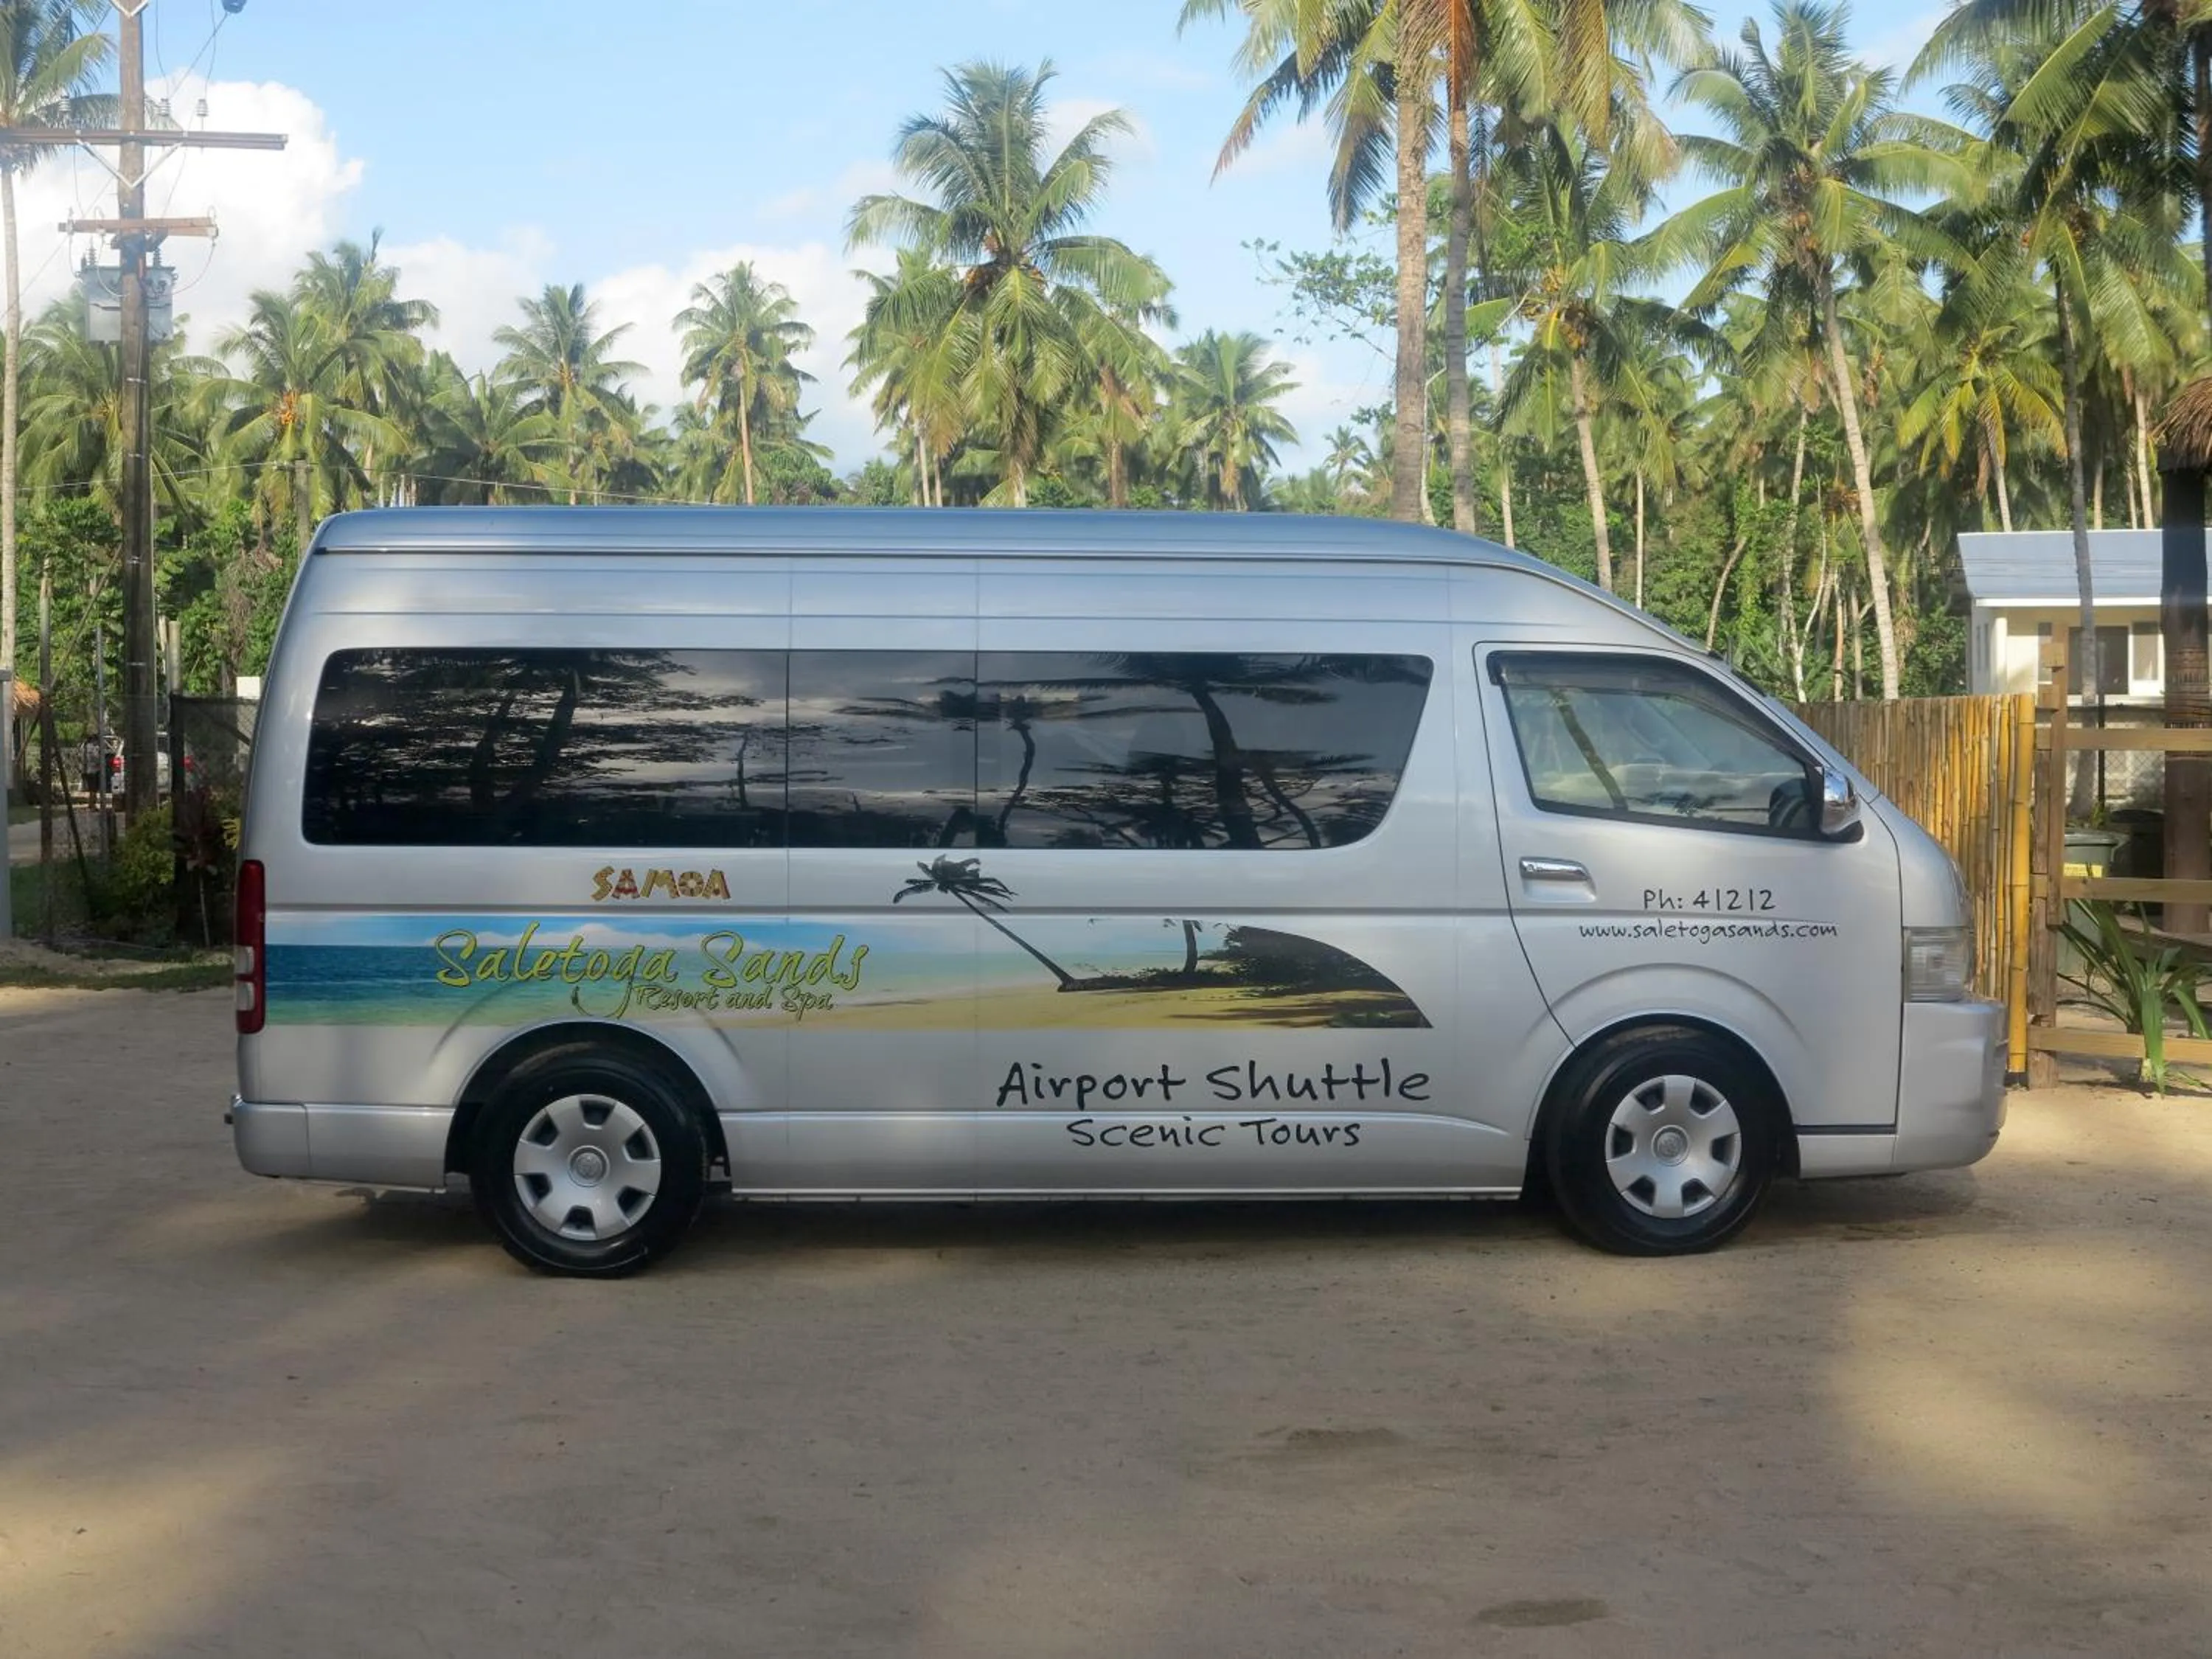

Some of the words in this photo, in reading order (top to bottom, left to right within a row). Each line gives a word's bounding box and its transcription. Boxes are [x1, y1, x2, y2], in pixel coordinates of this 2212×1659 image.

[591, 866, 731, 901] SAMOA
[1643, 889, 1683, 910] Ph:
[1692, 888, 1777, 911] 41212
[1579, 919, 1838, 944] www.saletogasands.com
[435, 921, 678, 1019] Saletoga
[700, 931, 869, 990] Sands
[635, 985, 719, 1011] Resort
[725, 987, 772, 1009] and
[781, 987, 833, 1021] Spa
[996, 1062, 1186, 1110] Airport
[1206, 1058, 1430, 1102] Shuttle
[1067, 1116, 1225, 1147] Scenic
[1239, 1119, 1361, 1147] Tours
